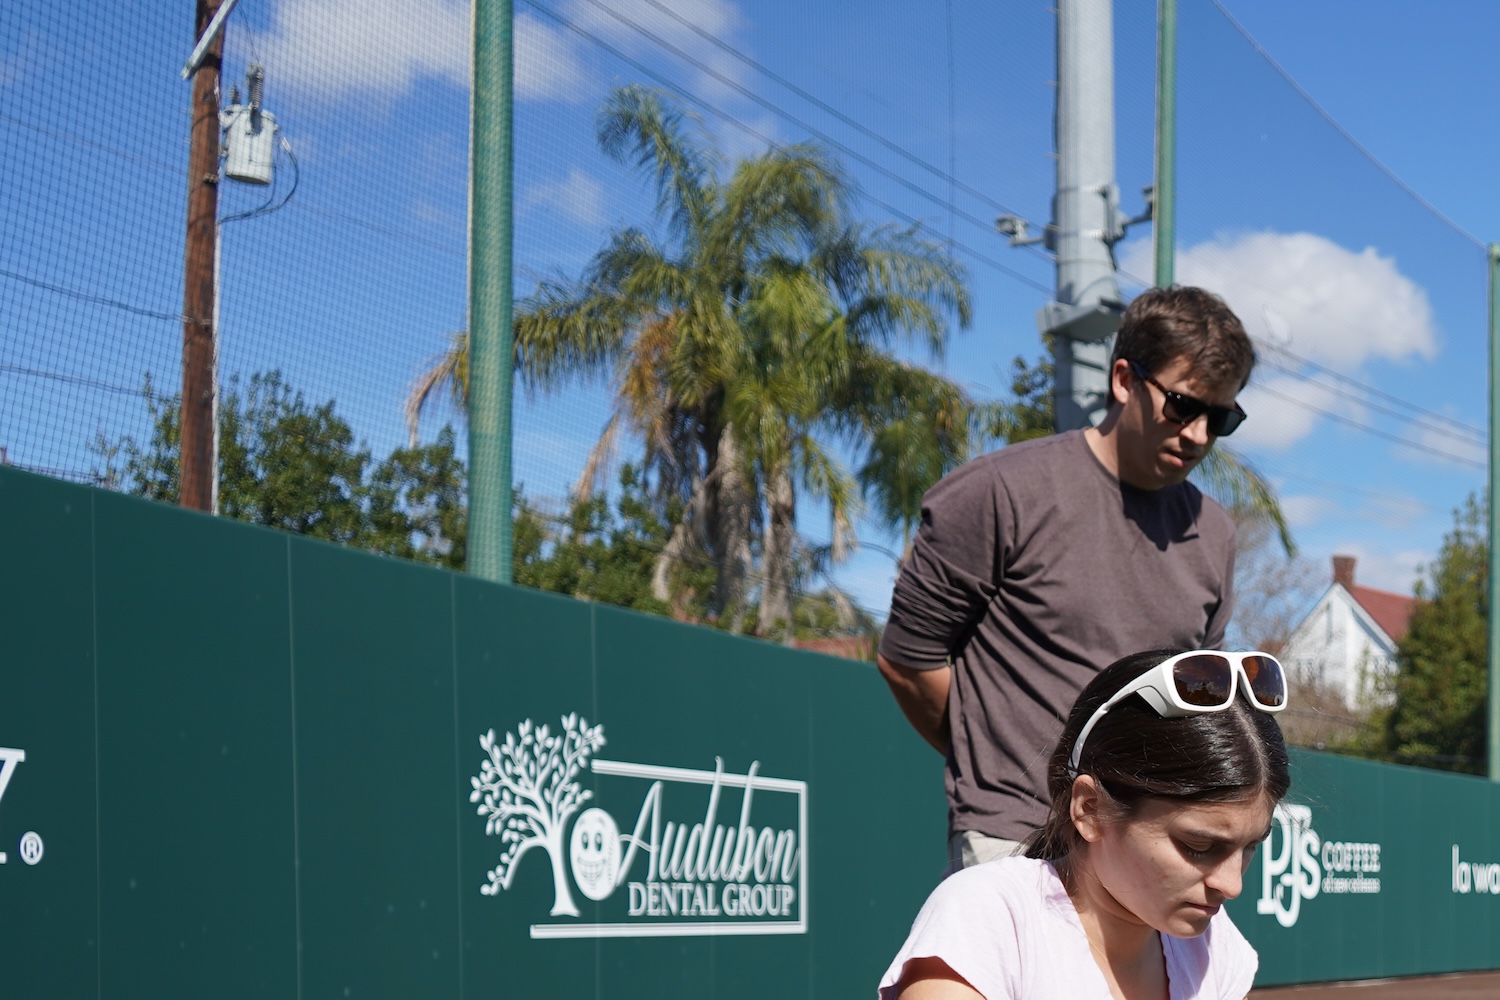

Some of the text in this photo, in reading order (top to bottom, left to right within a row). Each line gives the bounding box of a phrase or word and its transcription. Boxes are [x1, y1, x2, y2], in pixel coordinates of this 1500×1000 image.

[616, 756, 800, 887] Audubon
[1321, 841, 1381, 872] COFFEE
[628, 881, 796, 917] DENTAL GROUP
